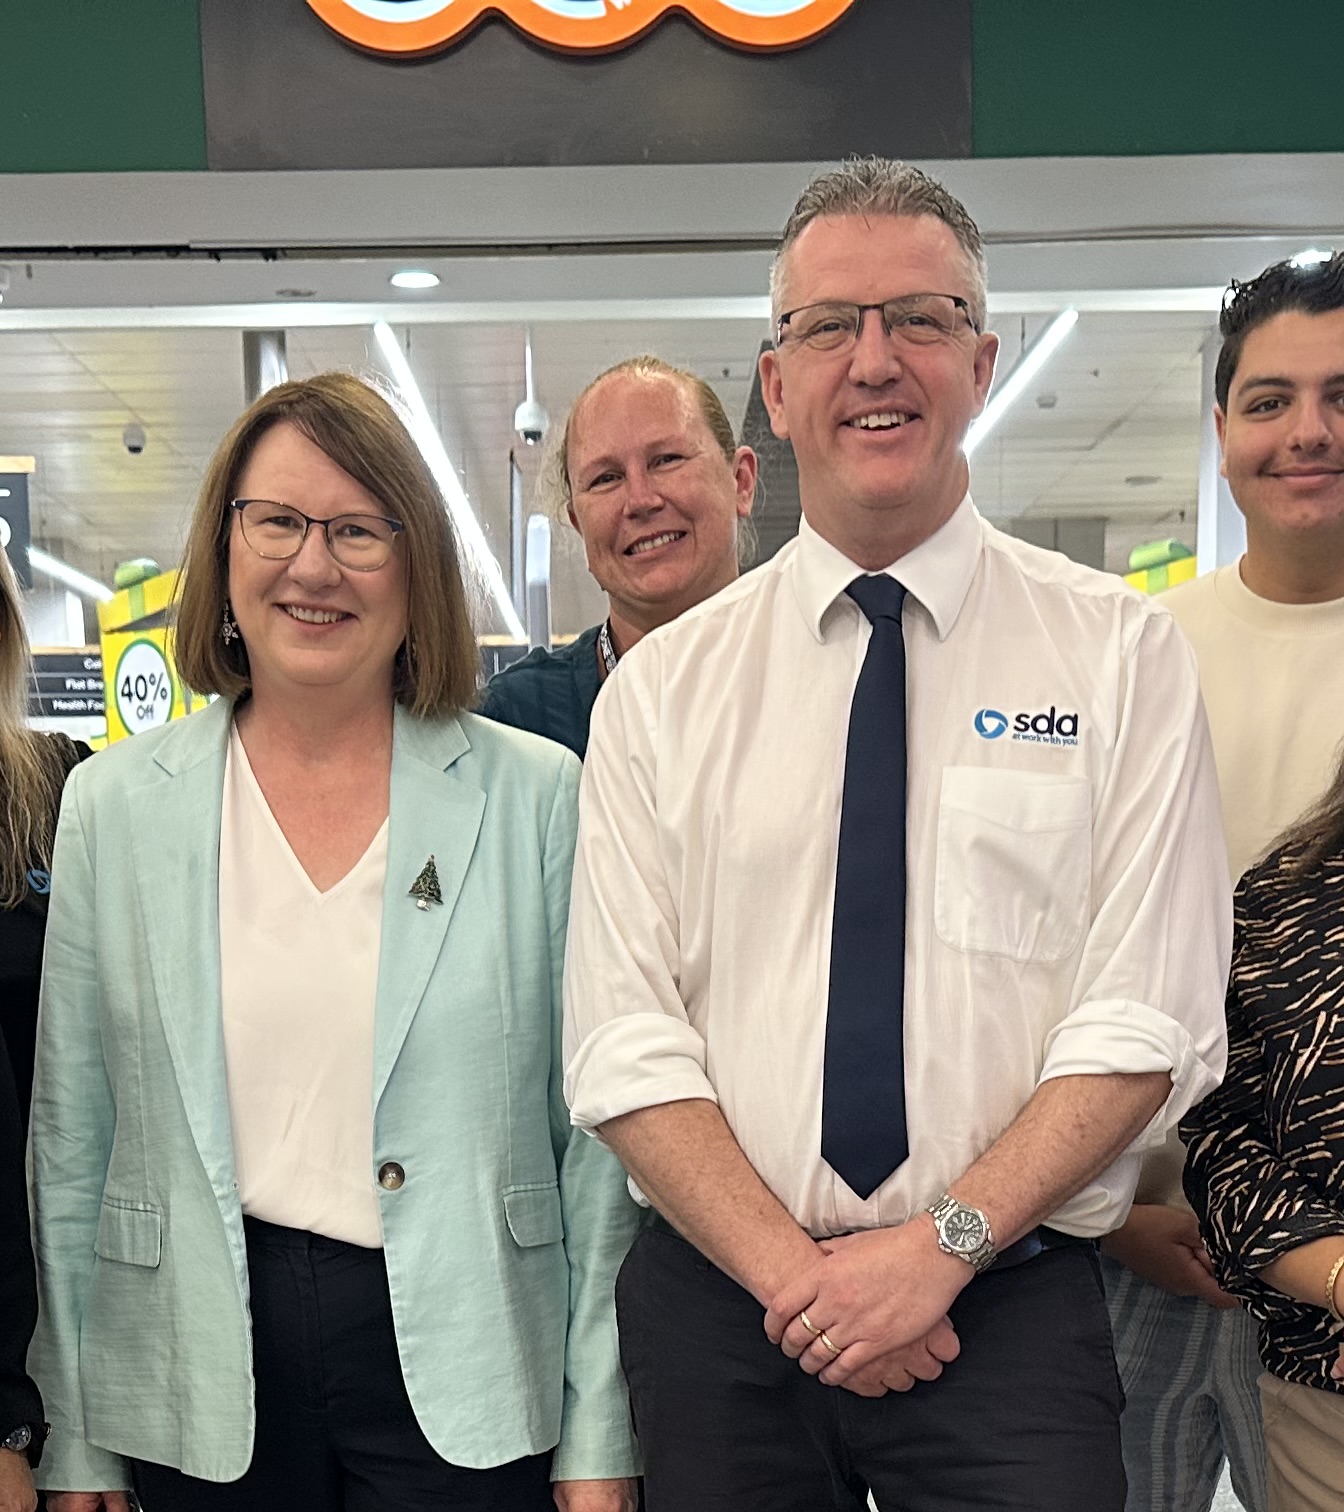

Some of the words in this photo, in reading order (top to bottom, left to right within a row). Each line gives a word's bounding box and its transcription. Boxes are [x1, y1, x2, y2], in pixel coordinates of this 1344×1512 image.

[121, 672, 168, 703] 40%
[136, 703, 155, 721] Off
[1013, 705, 1079, 736] sda
[1021, 734, 1042, 742] work
[1042, 735, 1062, 746] with
